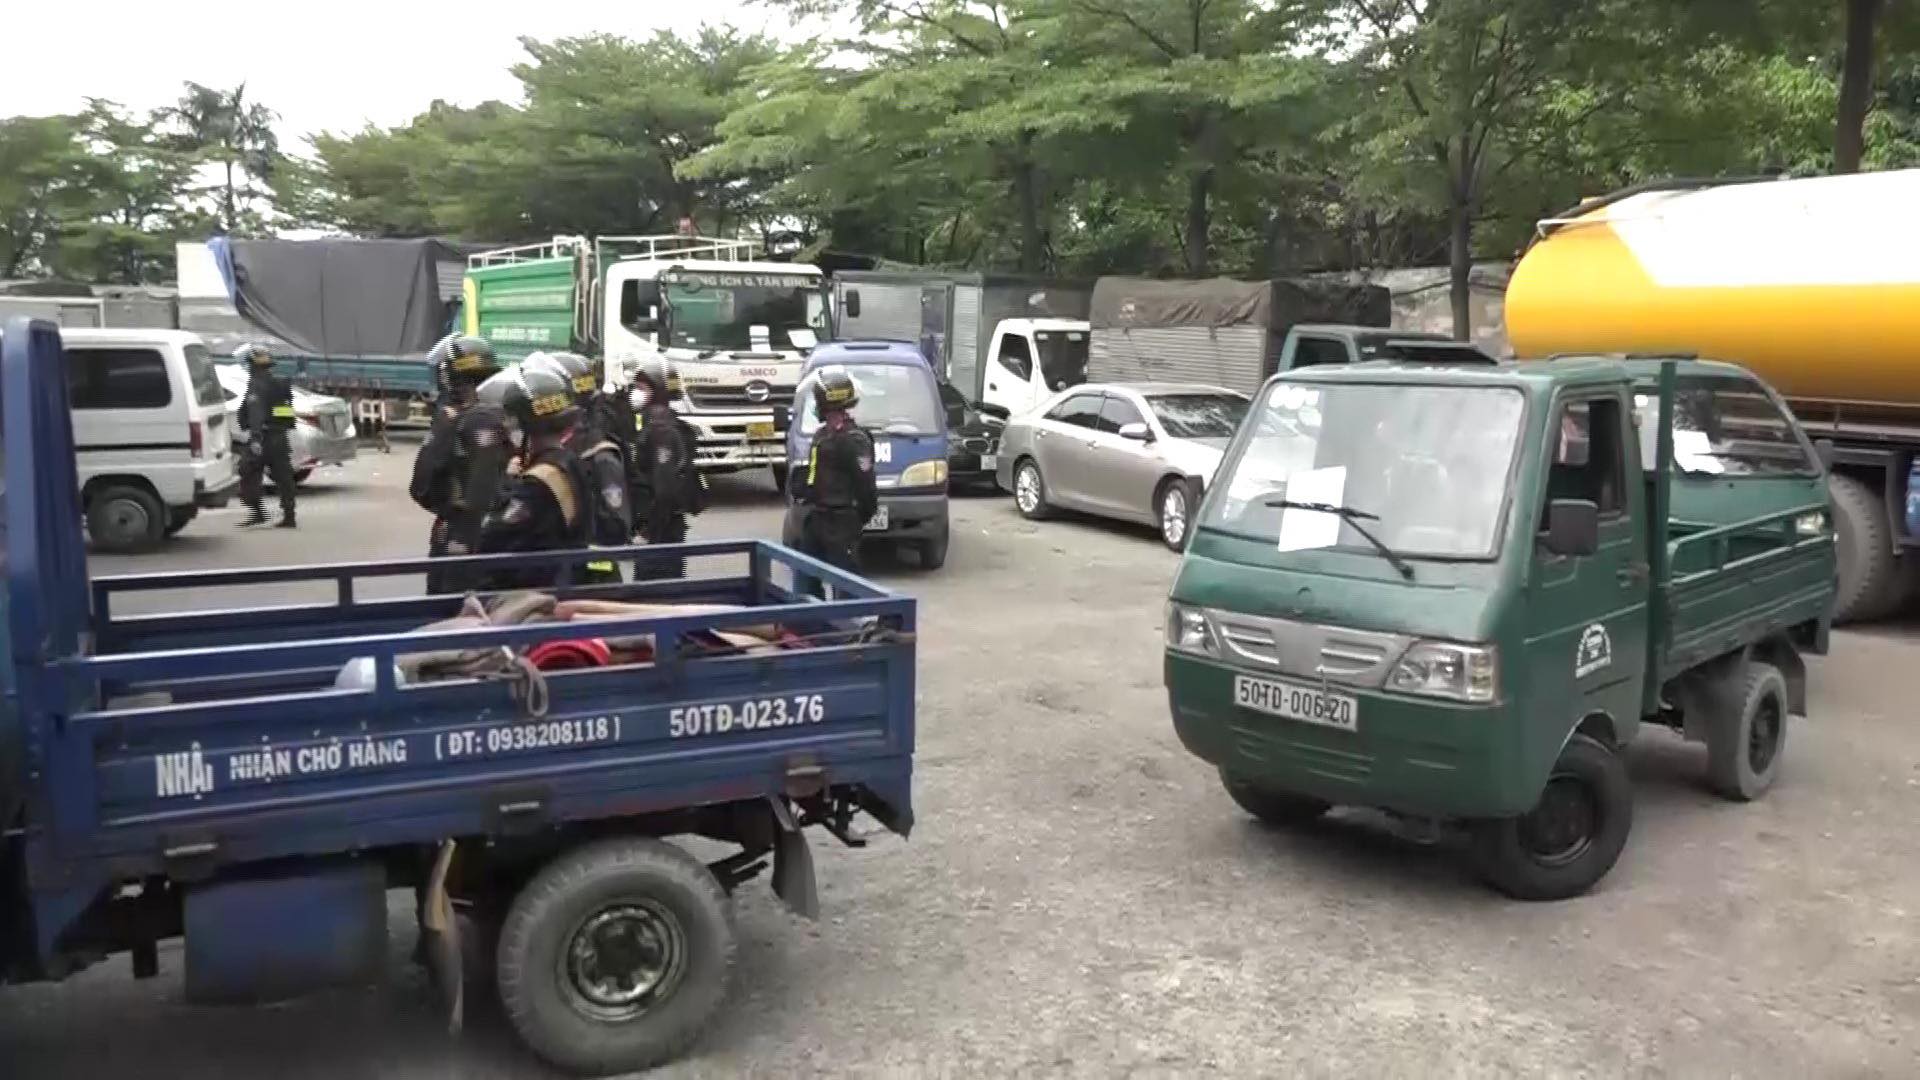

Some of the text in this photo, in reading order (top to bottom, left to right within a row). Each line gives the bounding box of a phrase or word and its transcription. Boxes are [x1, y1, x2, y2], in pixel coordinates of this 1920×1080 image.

[741, 367, 777, 376] SAMCO
[670, 694, 824, 737] 50TĐ-023.76
[229, 743, 291, 782] NHẬN
[348, 735, 407, 767] HÀNG
[487, 717, 609, 752] 0938208118
